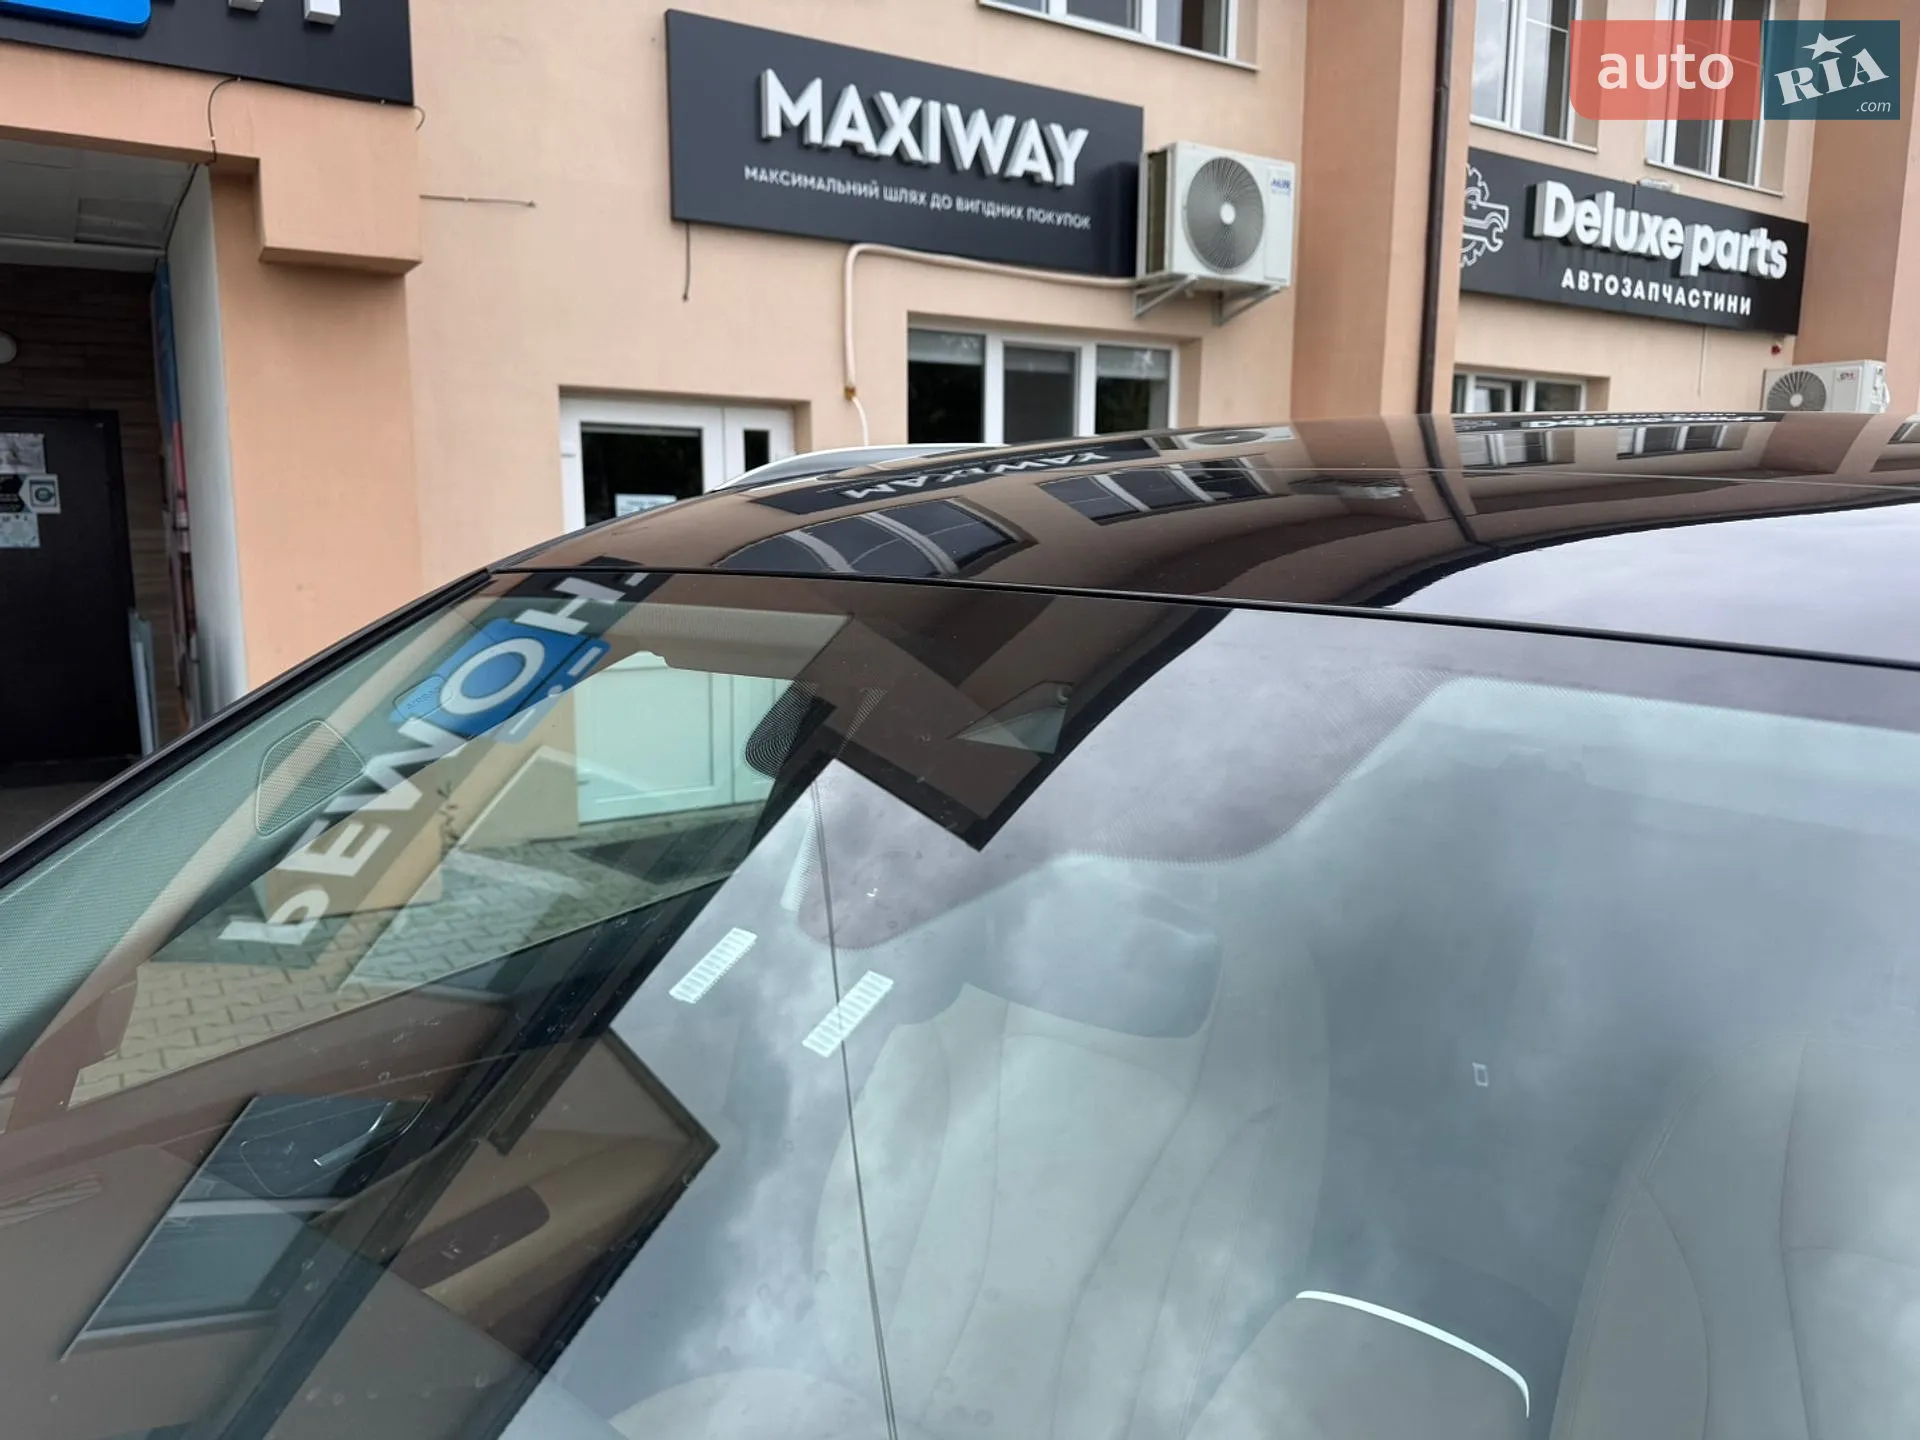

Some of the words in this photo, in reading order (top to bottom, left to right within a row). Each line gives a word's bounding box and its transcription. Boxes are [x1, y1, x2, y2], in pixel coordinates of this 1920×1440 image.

[760, 68, 1090, 187] MAXIWAY
[744, 165, 880, 200] МАКСИМАЛЬНИЙ
[882, 184, 928, 208] ШЛЯХ
[929, 192, 953, 212] ДО
[1026, 206, 1092, 230] ПОКУПОК
[1533, 179, 1684, 261] Deluxe
[1680, 223, 1789, 280] parts
[1560, 267, 1752, 317] АВТОЗАПЧАСТИНИ
